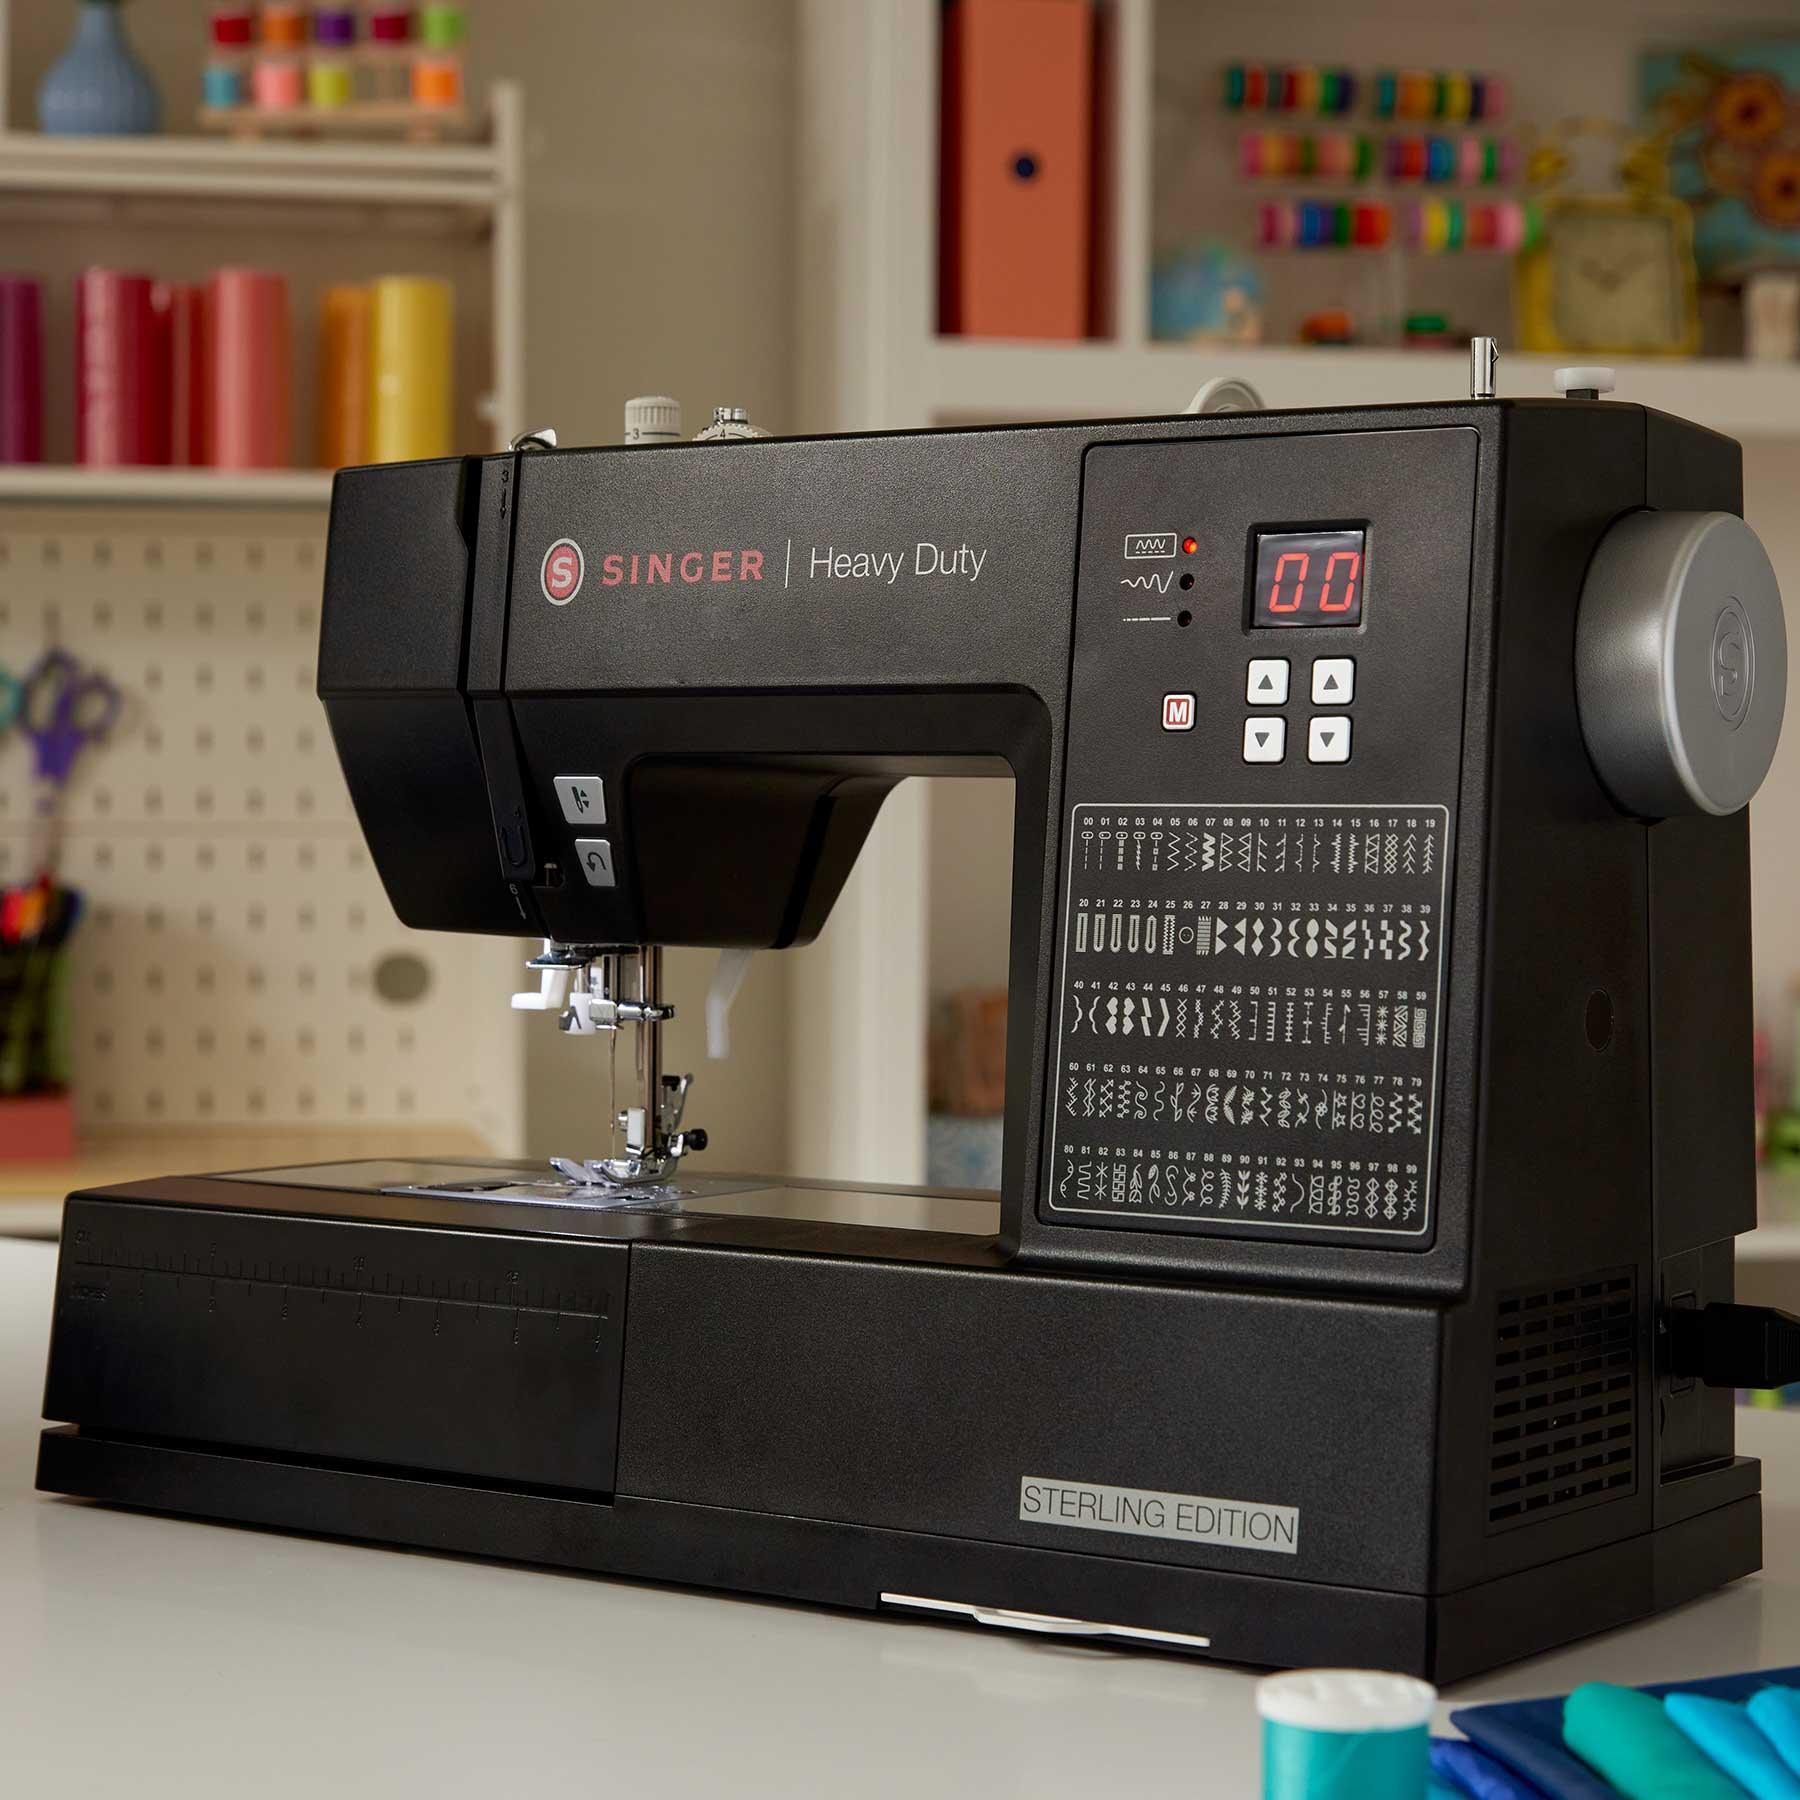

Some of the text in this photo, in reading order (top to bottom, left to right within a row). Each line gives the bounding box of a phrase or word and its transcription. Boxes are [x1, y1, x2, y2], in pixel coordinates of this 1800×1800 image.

[632, 429, 640, 440] 3
[719, 429, 726, 439] 4
[501, 470, 510, 482] 3
[602, 542, 988, 586] SINGER Heavy Duty
[1269, 551, 1361, 613] 00
[1168, 701, 1188, 723] M
[1083, 816, 1436, 828] 00 01 02 03 04 05 06 07 08 09 10 11 12 13 14 15 16 17 18 19
[1078, 898, 1431, 914] 20 21 22 23 24 25 26 27 28 29 30 31 32 33 34 35 36 37 38 39
[1073, 980, 1427, 1001] 40 41 42 43 44 45 46 47 48 49 50 51 52 53 54 55 56 57 58 59
[1068, 1062, 1423, 1087] 60 61 62 63 64 65 66 67 68 69 70 71 72 73 74 75 76 77 78 79
[1063, 1144, 1074, 1154] 80
[1080, 1145, 1091, 1155] 81
[1097, 1146, 1109, 1156] 82
[1115, 1147, 1126, 1157] 83
[1132, 1148, 1143, 1158] 84
[1150, 1149, 1161, 1159] 85
[1167, 1150, 1179, 1160] 86
[1185, 1151, 1197, 1161] 87
[1203, 1152, 1215, 1162] 88
[1239, 1154, 1251, 1165] 90
[1257, 1155, 1268, 1166] 91
[1275, 1156, 1287, 1167] 92
[1293, 1157, 1305, 1168] 93
[1312, 1159, 1324, 1169] 94
[1330, 1159, 1343, 1170] 95
[1349, 1160, 1361, 1171] 96
[1368, 1162, 1380, 1172] 97
[1386, 1163, 1399, 1173] 98
[1405, 1164, 1418, 1174] 99
[1022, 1485, 1295, 1545] STERLING EDITION
